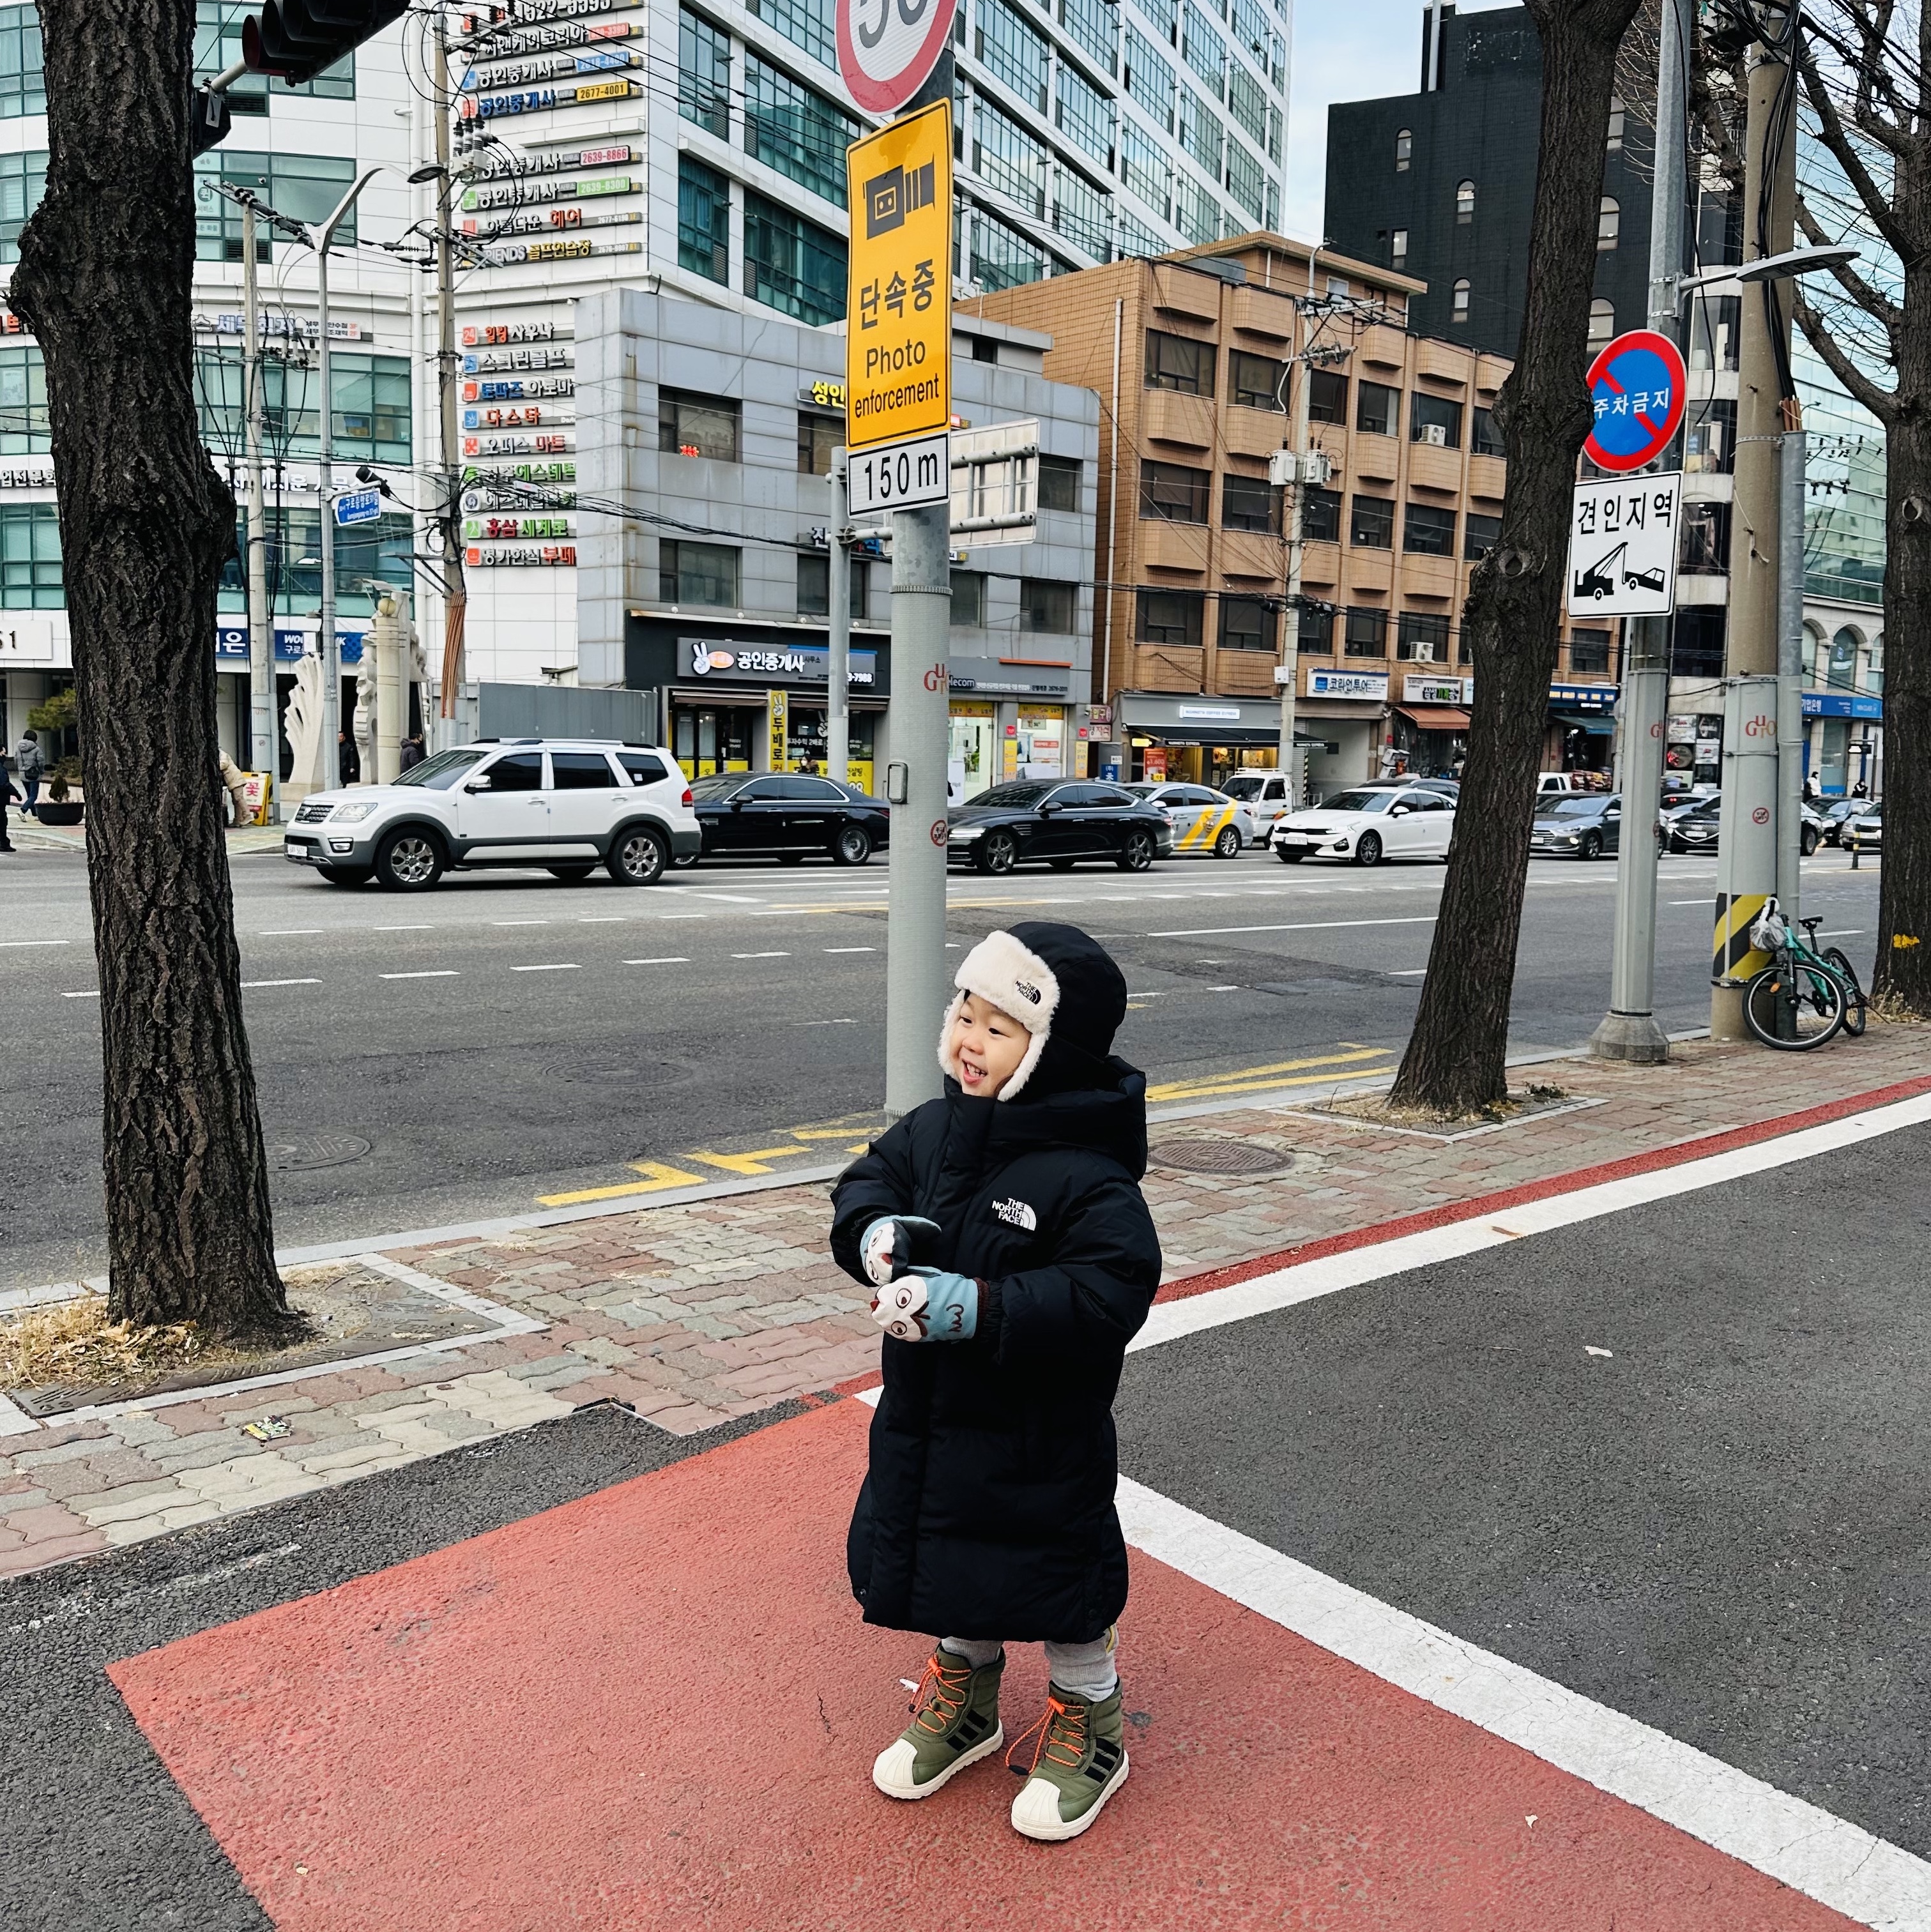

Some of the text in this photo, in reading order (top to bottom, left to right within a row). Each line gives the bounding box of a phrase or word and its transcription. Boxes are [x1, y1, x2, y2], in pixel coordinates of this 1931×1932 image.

[478, 59, 554, 87] 공인중개사
[480, 89, 556, 116] 공인중개사
[580, 84, 624, 99] 2677-4001
[482, 153, 560, 179] 공인중개사
[583, 148, 627, 164] 2639-8866
[478, 183, 556, 208] 공인중개사
[487, 214, 542, 234] 아름다운
[550, 208, 582, 228] 헤어
[484, 245, 526, 262] RIENDS
[528, 238, 592, 260] 골프연습장
[860, 259, 935, 330] 단속중
[512, 322, 554, 340] 사우나
[480, 348, 565, 371] 스크린골프
[866, 338, 926, 379] Photo
[528, 378, 574, 397] 아로마
[812, 381, 846, 408] 성인
[855, 372, 940, 418] enforcement
[1594, 387, 1670, 419] 주차금지
[486, 407, 542, 427] 다스타
[485, 435, 565, 454] 오피스 마트
[864, 452, 938, 501] 150 m
[1578, 489, 1673, 535] 견인지역
[487, 518, 569, 538] 홍삼 세계로
[482, 548, 541, 566] 명가한식
[737, 651, 805, 673] 공인중개사
[992, 1200, 1022, 1218] NORTH
[1007, 1198, 1025, 1210] THE
[998, 1211, 1020, 1226] FACE
